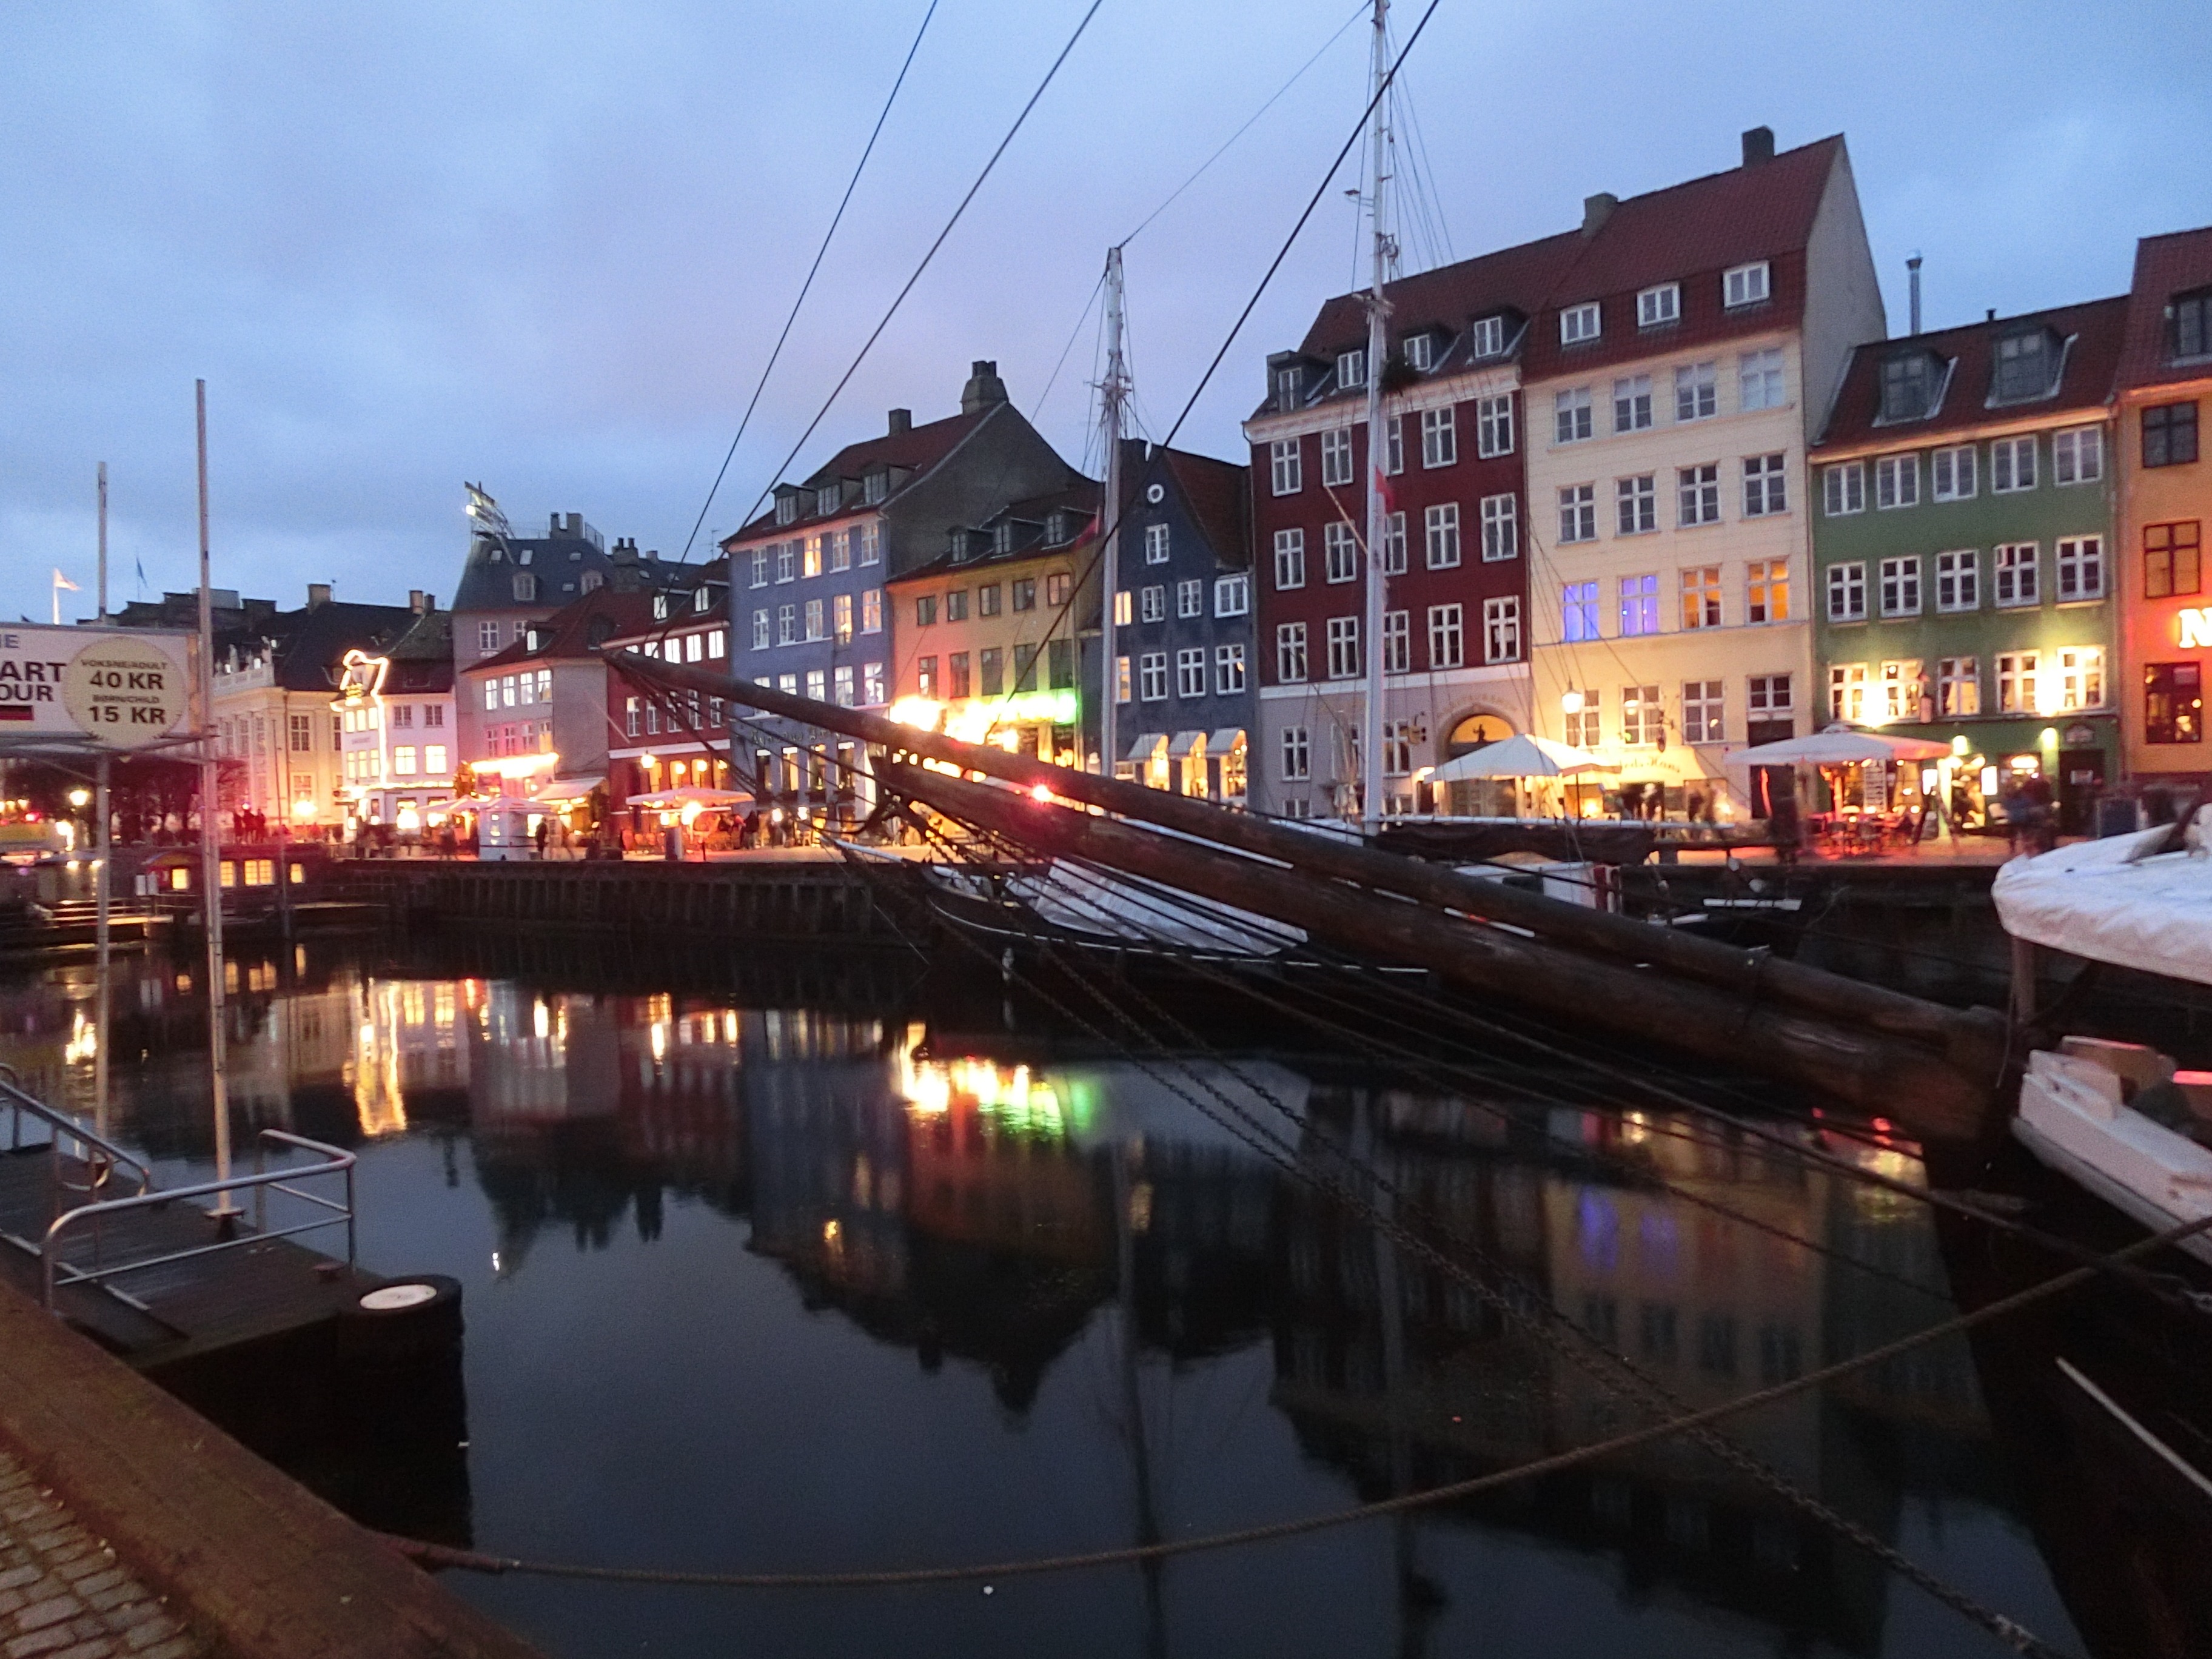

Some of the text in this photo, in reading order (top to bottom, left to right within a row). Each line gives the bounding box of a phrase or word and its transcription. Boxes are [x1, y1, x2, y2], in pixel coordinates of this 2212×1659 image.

[0, 634, 19, 648] E
[90, 670, 164, 690] 40 KR
[89, 706, 166, 724] 15 KR
